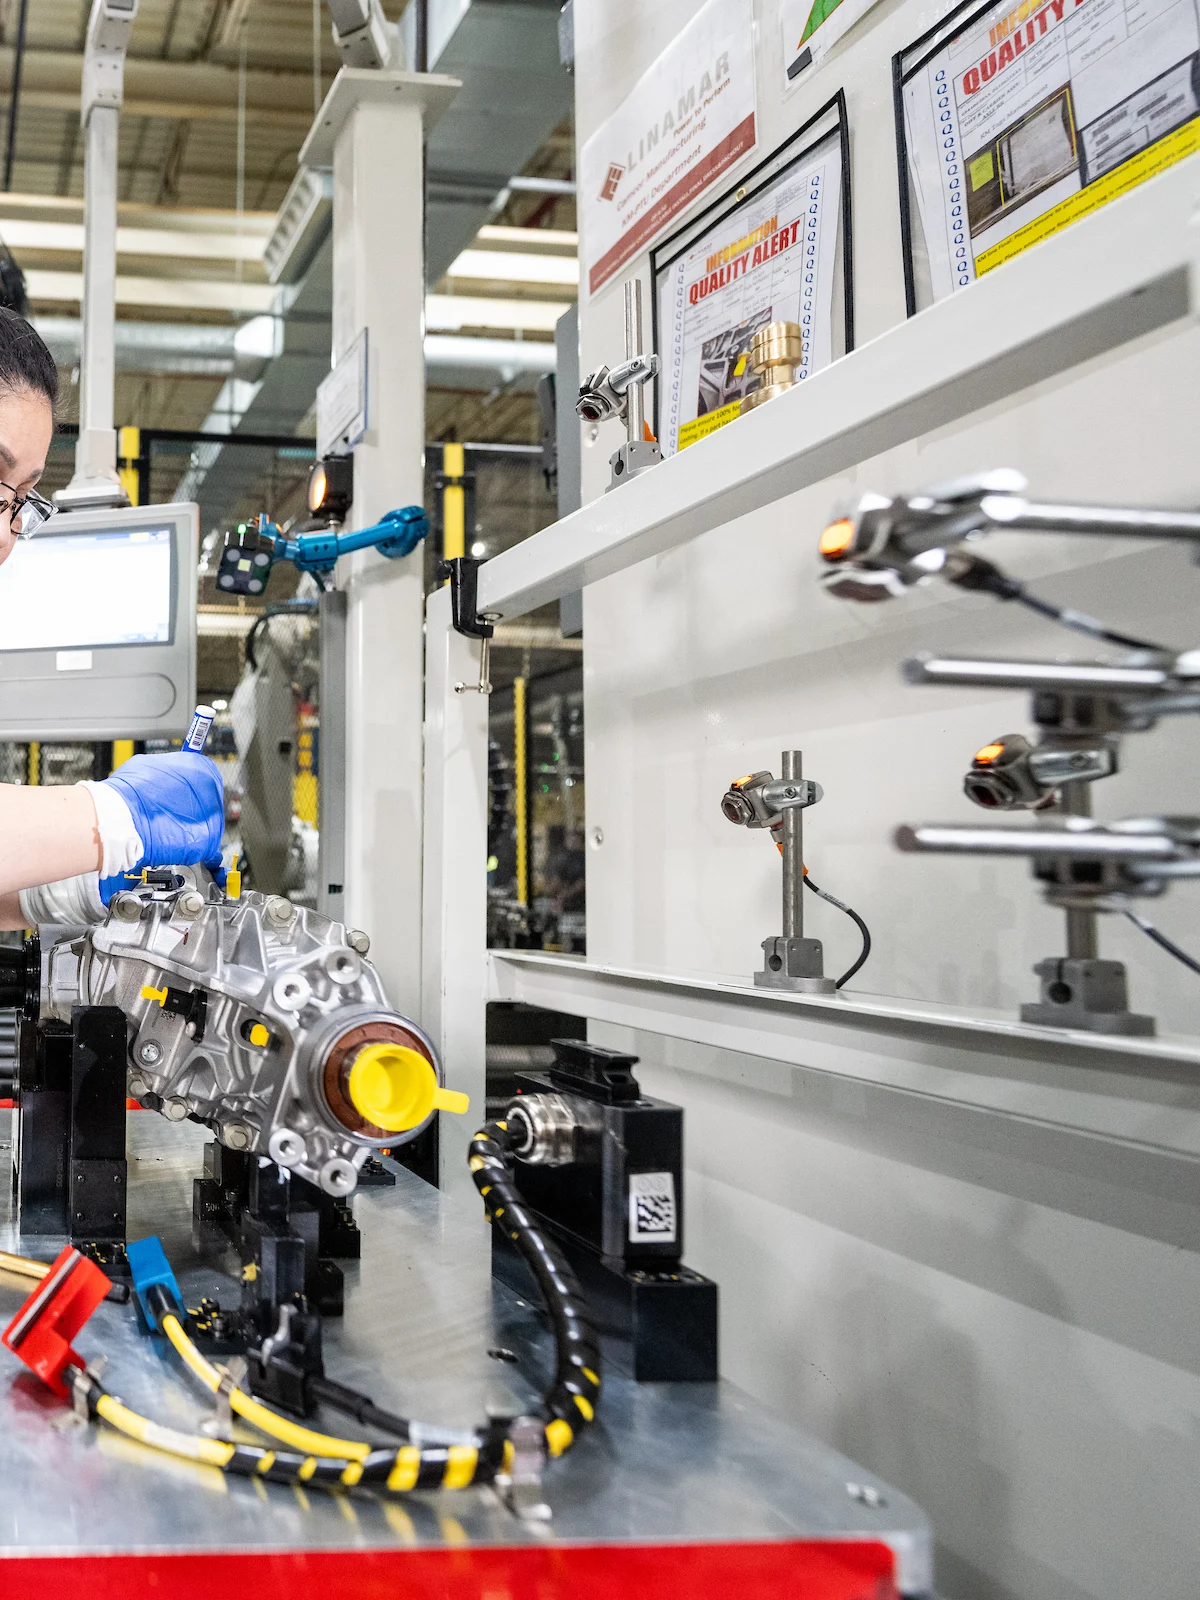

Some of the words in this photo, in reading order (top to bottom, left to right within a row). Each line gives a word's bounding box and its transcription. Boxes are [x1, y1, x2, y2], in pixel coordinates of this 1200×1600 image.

[963, 0, 1064, 95] QUALITY
[628, 51, 729, 173] LINAMAR
[673, 114, 693, 139] Power
[695, 107, 702, 117] to
[704, 77, 731, 108] Perform
[1006, 84, 1048, 120] Management
[646, 116, 706, 182] Manufacturing
[651, 145, 702, 199] Department
[706, 215, 778, 273] INFORMATION
[1004, 245, 1022, 261] Please
[1023, 233, 1042, 248] ensure
[1014, 224, 1032, 240] Please
[1034, 212, 1053, 227] ensure
[1055, 206, 1061, 214] to
[689, 252, 750, 305] QUALITY
[752, 219, 800, 269] ALERT
[681, 424, 697, 434] Please
[698, 416, 715, 427] ensure
[716, 408, 731, 419] 100%
